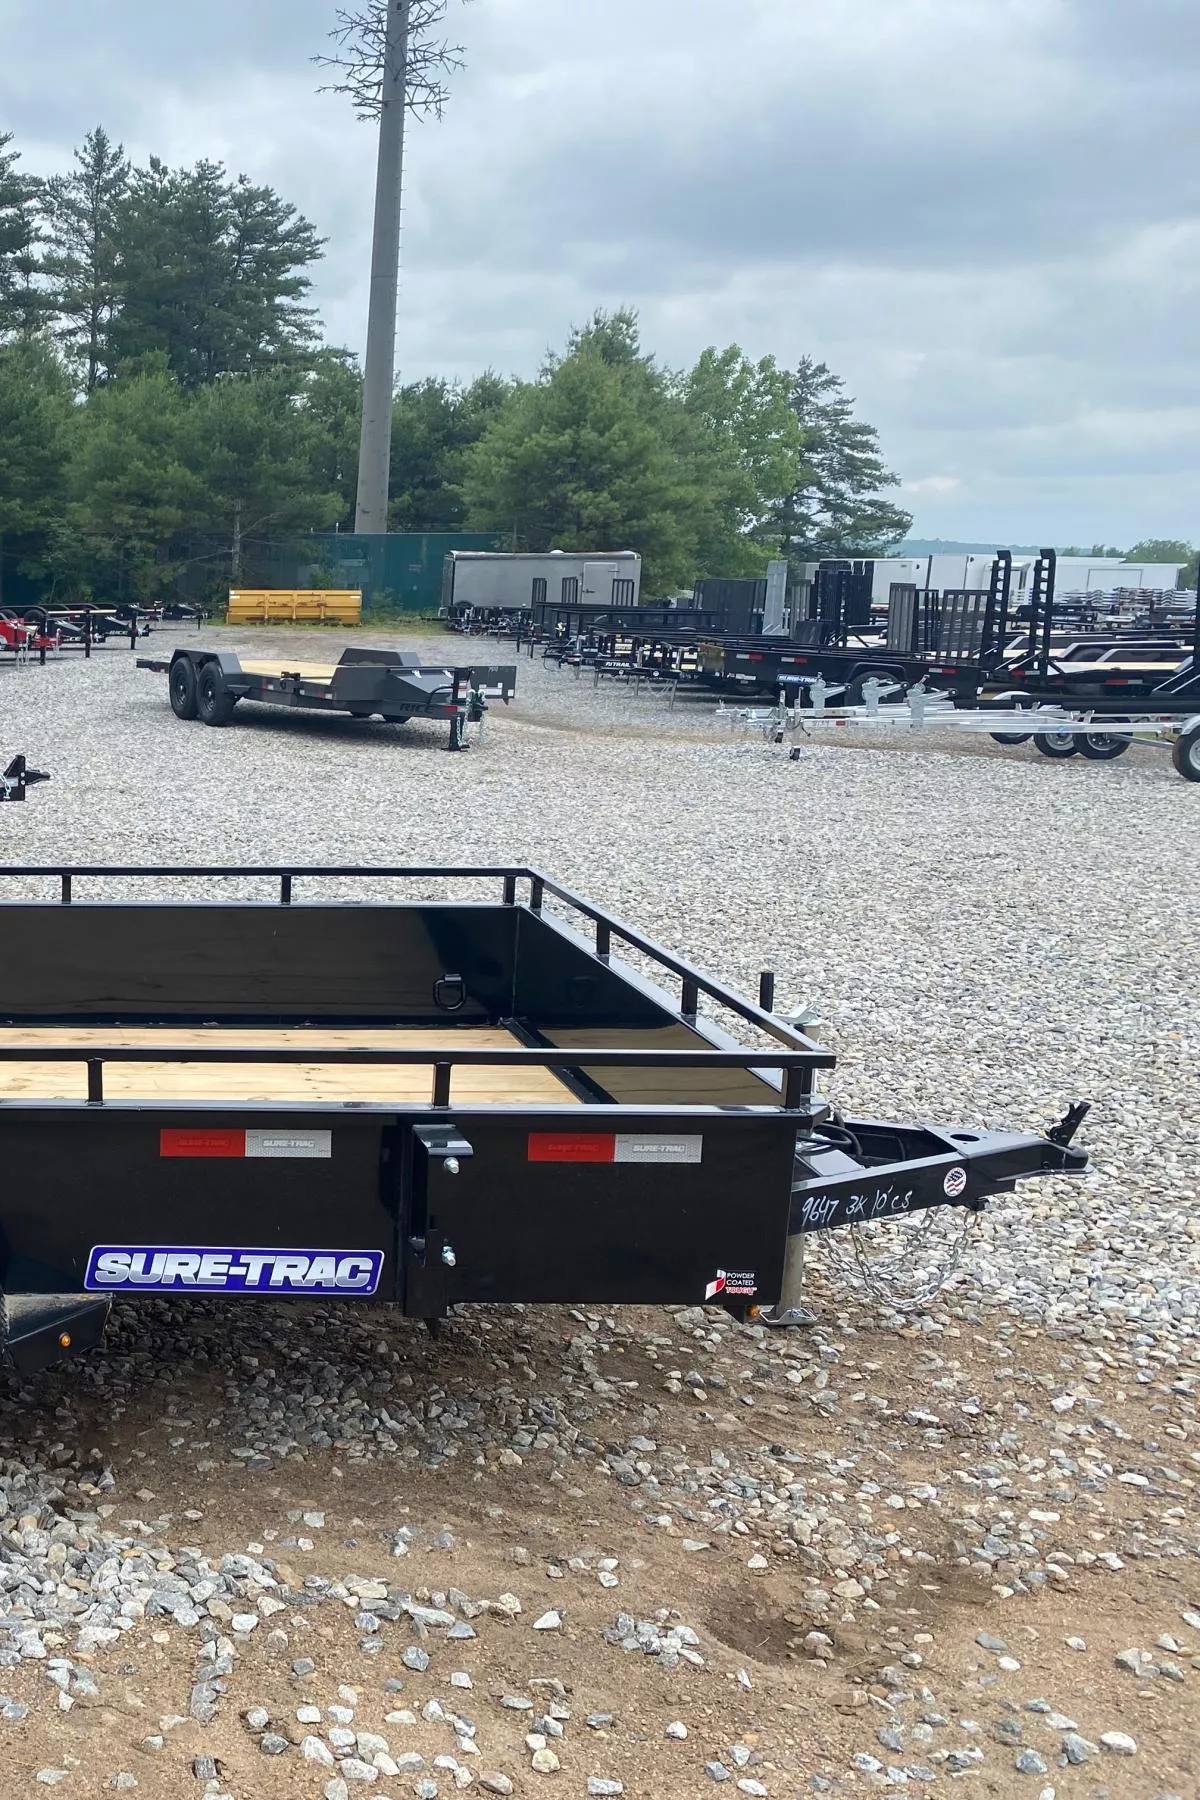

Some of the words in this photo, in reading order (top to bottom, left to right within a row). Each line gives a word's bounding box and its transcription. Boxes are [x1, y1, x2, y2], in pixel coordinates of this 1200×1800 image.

[262, 1139, 316, 1148] SURE-TRAC
[632, 1144, 686, 1152] SURE-TRAC
[94, 1252, 374, 1288] SURE-TRAC
